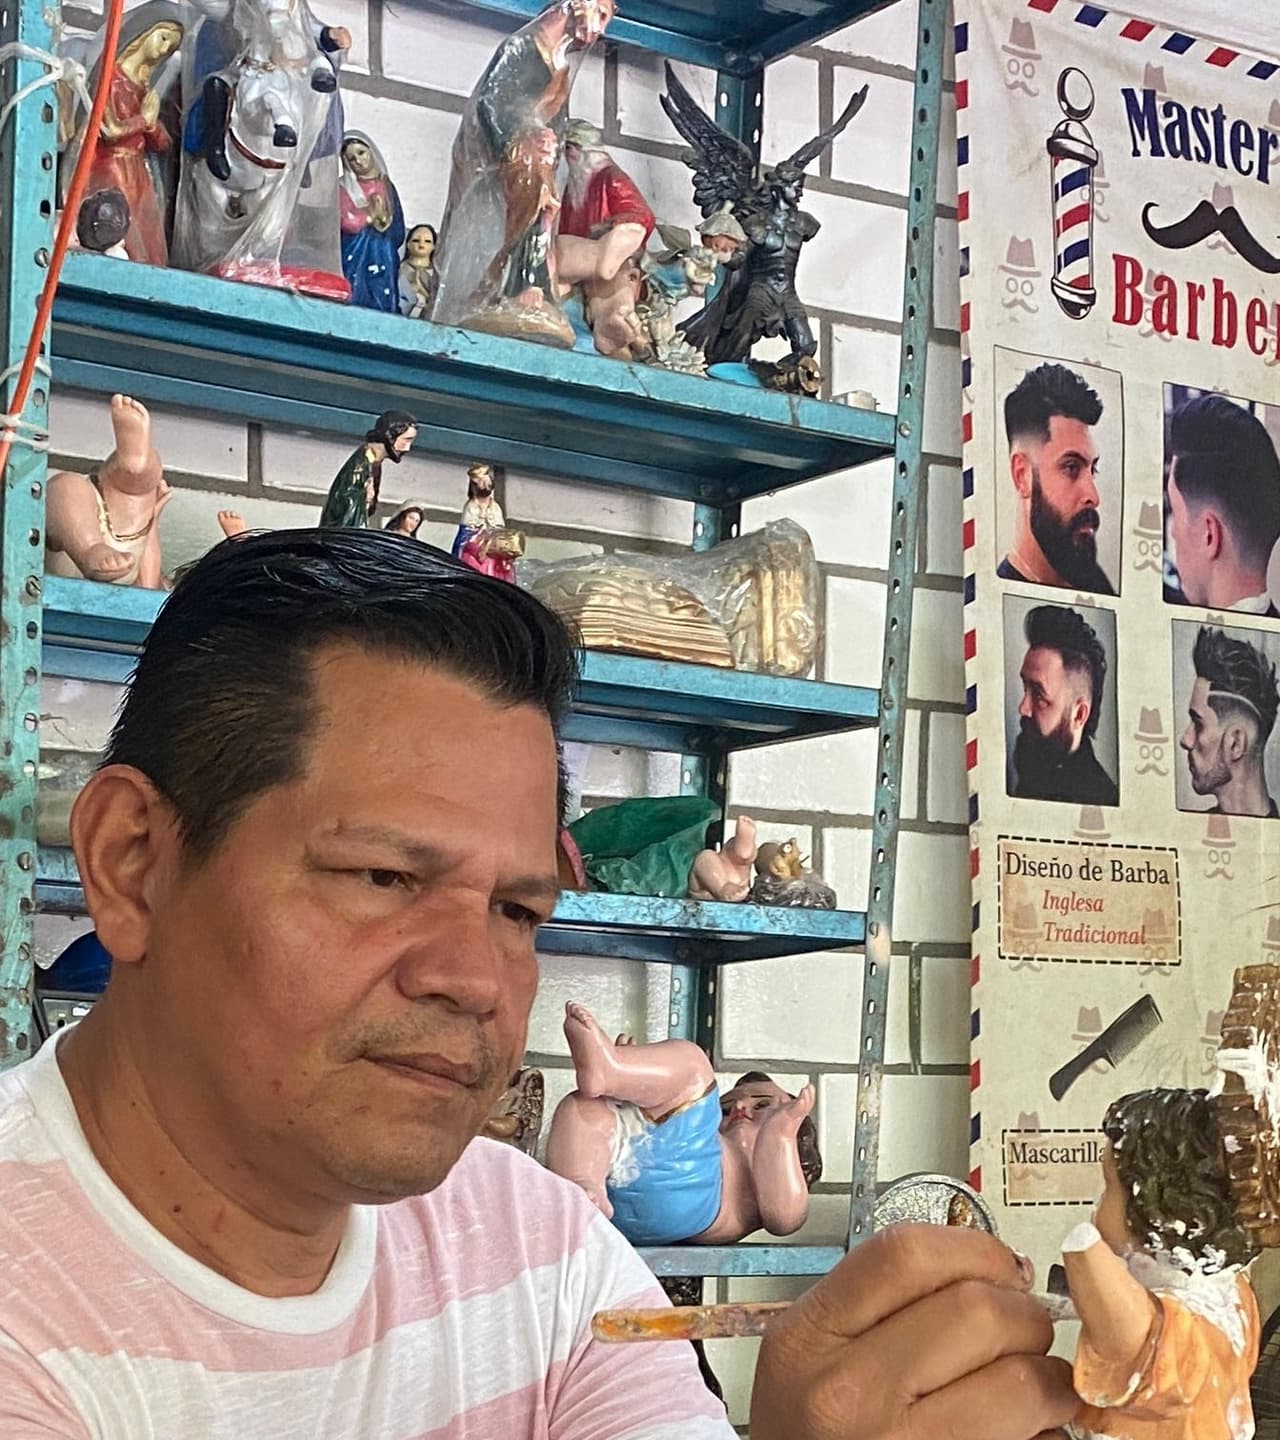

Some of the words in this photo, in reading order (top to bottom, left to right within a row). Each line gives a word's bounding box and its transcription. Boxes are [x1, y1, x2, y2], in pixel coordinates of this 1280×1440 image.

[1006, 852, 1073, 881] Diseño
[1079, 858, 1103, 882] de
[1111, 859, 1170, 885] Barba
[1042, 889, 1104, 916] Inglesa
[1043, 921, 1147, 945] Tradicional
[1009, 1141, 1105, 1164] Mascarilla
